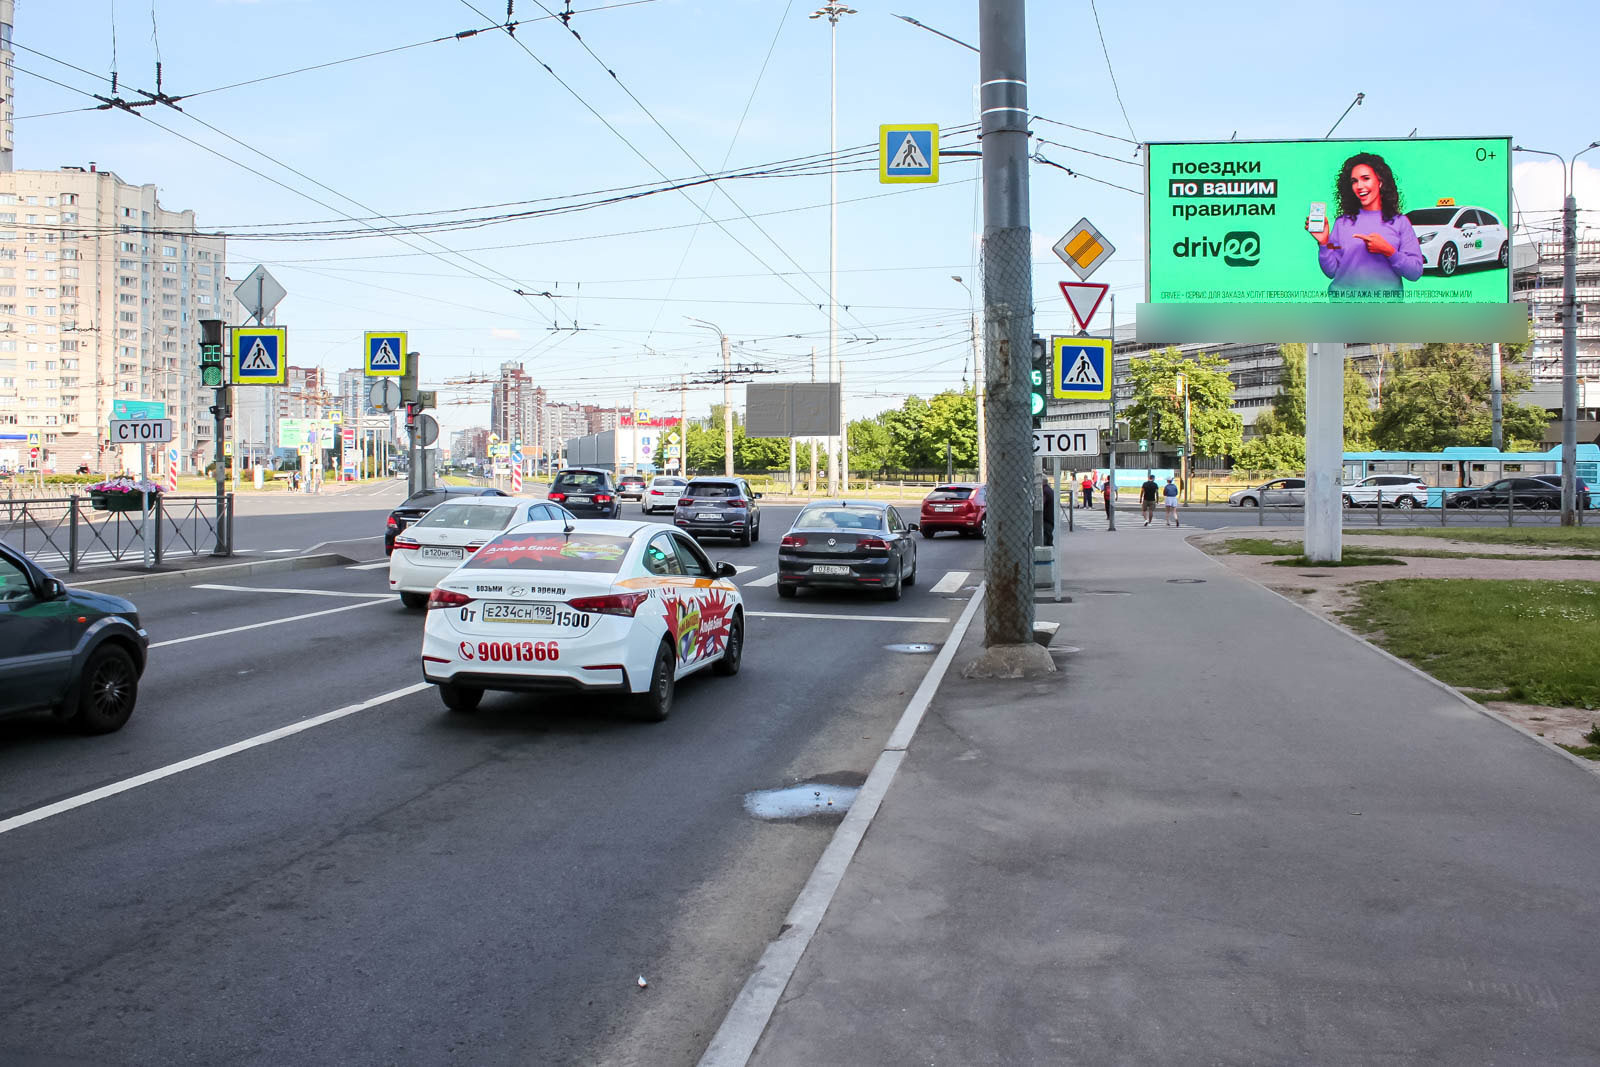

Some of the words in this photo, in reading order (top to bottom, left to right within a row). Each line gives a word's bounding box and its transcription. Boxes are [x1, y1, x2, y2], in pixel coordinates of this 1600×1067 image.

[1475, 147, 1497, 162] 0+
[1172, 161, 1261, 176] поездки
[1172, 182, 1198, 196] по
[1203, 182, 1275, 195] вашим
[1172, 203, 1276, 221] правилам
[1172, 235, 1260, 262] drivee
[1222, 290, 1245, 299] ЗАКАЗА
[203, 344, 221, 362] 26
[118, 423, 163, 440] СТОП
[1032, 433, 1087, 452] СТОП
[537, 586, 567, 595] аренду
[460, 607, 477, 622] От
[487, 605, 532, 619] Е234СН
[534, 606, 551, 616] 198
[556, 611, 590, 628] 1500
[478, 640, 560, 662] 9001366
